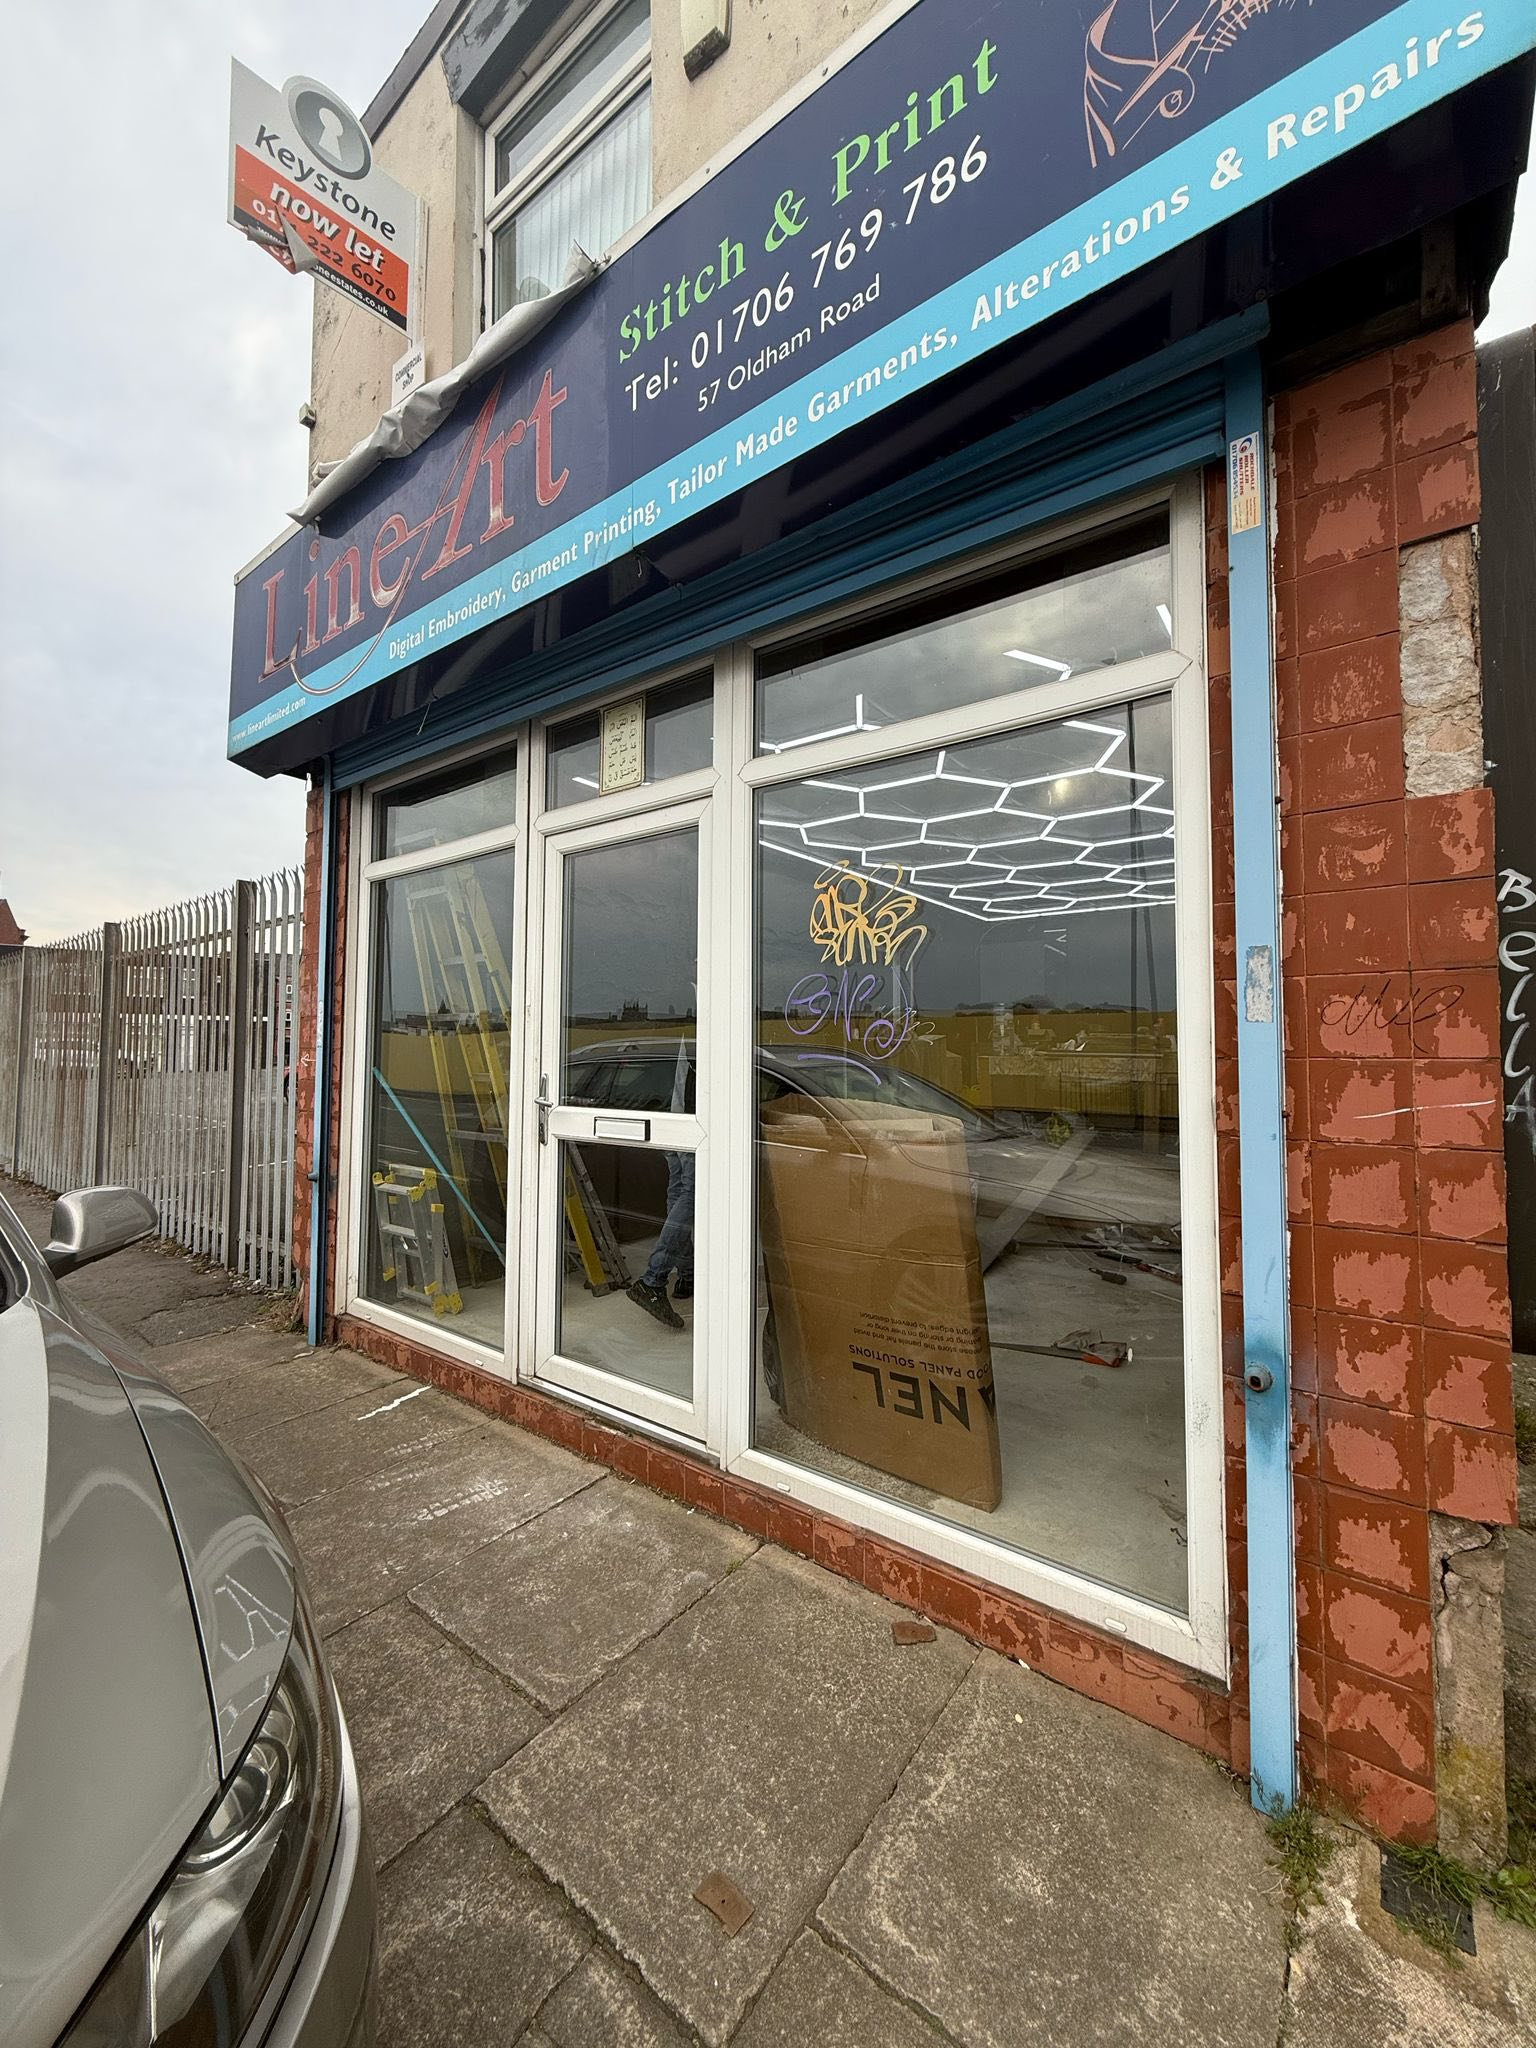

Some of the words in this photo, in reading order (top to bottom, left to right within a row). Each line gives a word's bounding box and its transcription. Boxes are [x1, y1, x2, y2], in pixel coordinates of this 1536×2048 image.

[255, 124, 397, 242] Keystone
[270, 182, 340, 241] now
[344, 227, 386, 275] let
[619, 236, 747, 364] Stitch
[764, 189, 809, 253] &
[832, 38, 999, 207] Print
[307, 234, 344, 267] 222
[351, 263, 396, 302] 6070
[625, 356, 679, 412] Tel:
[690, 271, 794, 369] 01706
[811, 208, 883, 289] 769
[902, 134, 988, 225] 786
[389, 624, 424, 660] Digital
[428, 586, 506, 638] Embroidery,
[511, 543, 578, 593] Garment
[584, 499, 661, 555] Printing,
[667, 456, 727, 505] Tailor
[735, 415, 797, 467] Made
[807, 327, 958, 423] Garments,
[970, 184, 1190, 331] Alterations
[1209, 147, 1244, 191] &
[1266, 10, 1485, 160] Repairs
[697, 378, 721, 412] 57
[727, 326, 811, 391] Oldham
[819, 273, 881, 333] Road
[848, 1344, 915, 1368] SOLUTIONS
[919, 1361, 962, 1378] PANEL
